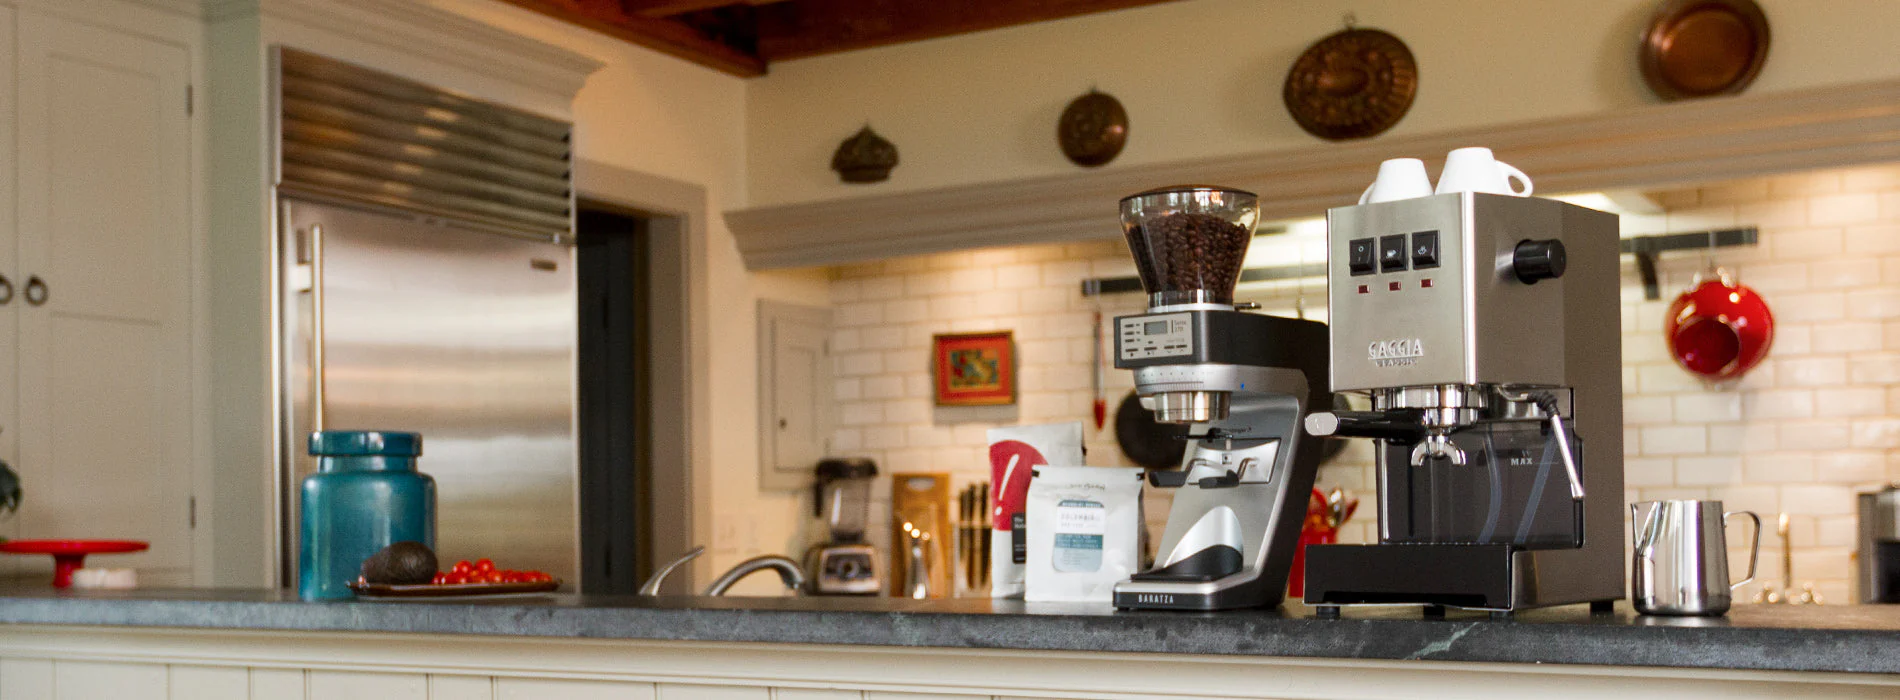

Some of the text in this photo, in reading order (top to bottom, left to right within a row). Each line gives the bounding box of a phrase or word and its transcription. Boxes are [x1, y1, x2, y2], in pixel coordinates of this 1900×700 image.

[1368, 338, 1424, 359] GAGGIA
[1510, 457, 1533, 466] MAX
[1138, 594, 1174, 604] BARATZA
